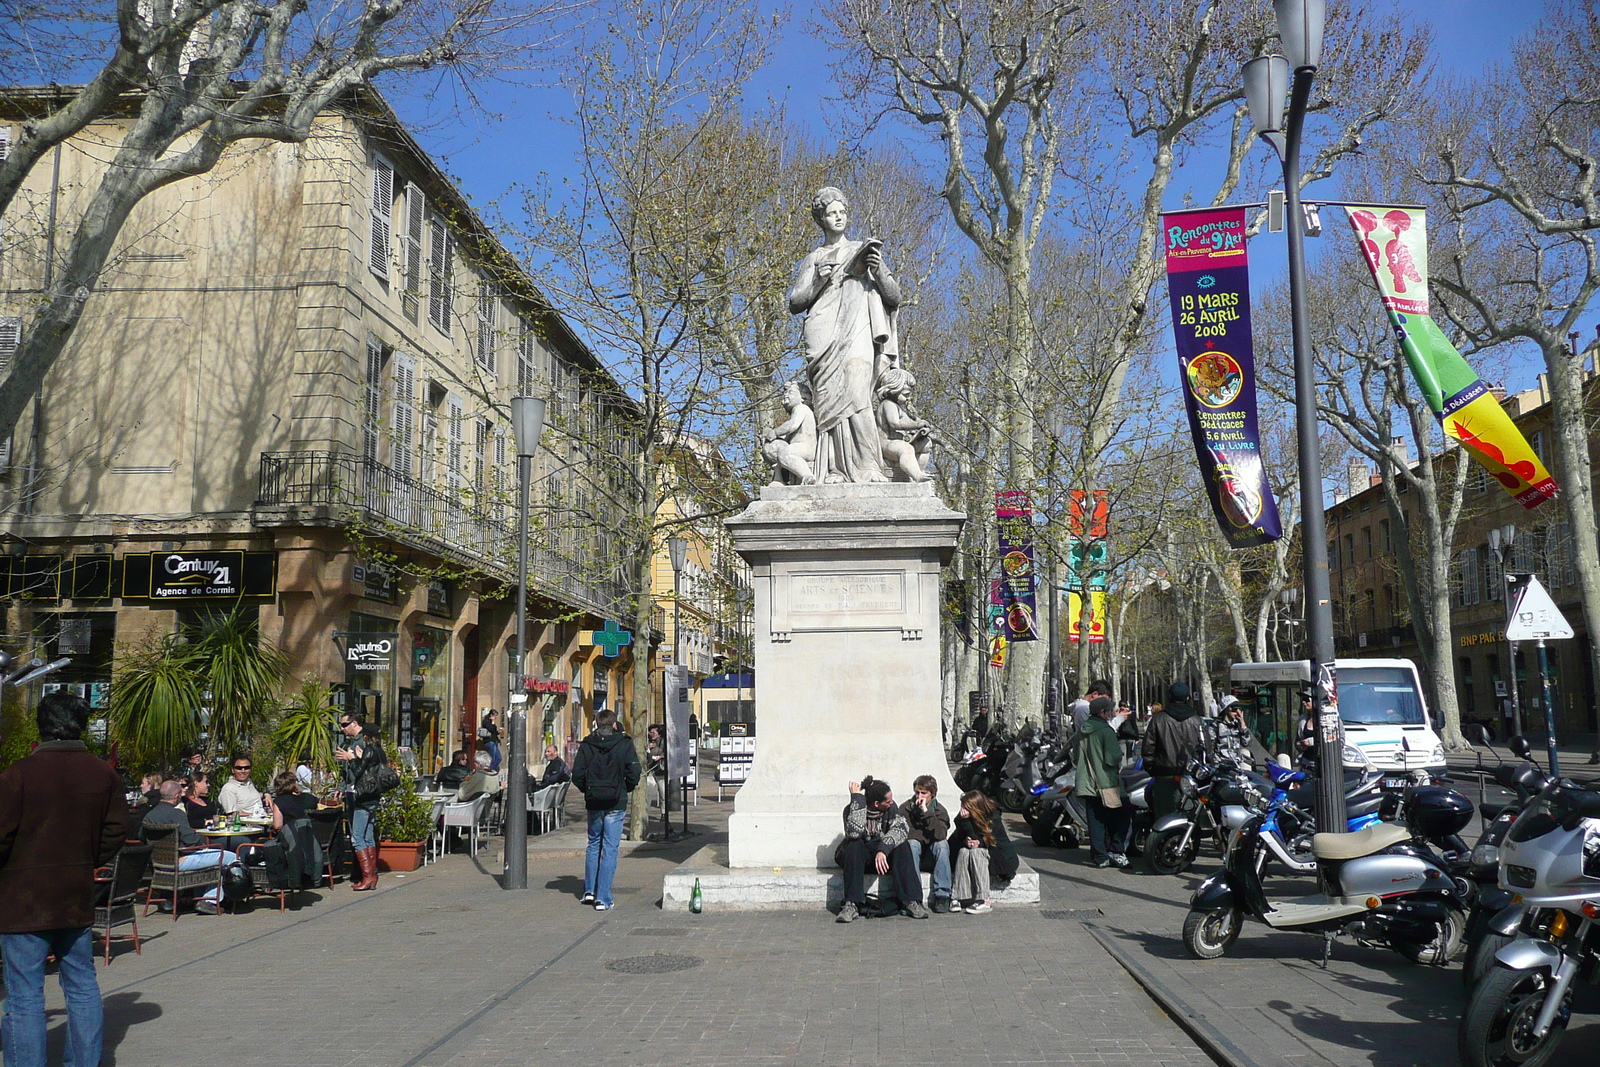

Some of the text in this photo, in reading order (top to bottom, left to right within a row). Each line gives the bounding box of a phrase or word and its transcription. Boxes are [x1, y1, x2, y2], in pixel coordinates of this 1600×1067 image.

[1200, 235, 1210, 244] du
[1181, 295, 1194, 310] 19
[1180, 312, 1196, 325] 26
[1195, 322, 1227, 338] 2008
[1213, 442, 1225, 450] du
[164, 554, 220, 574] Century
[213, 567, 230, 584] 21
[156, 586, 236, 597] Agence de Cormis
[800, 585, 826, 595] ARTS
[842, 584, 894, 594] SCIENCES
[1460, 631, 1505, 647] BNP PARB
